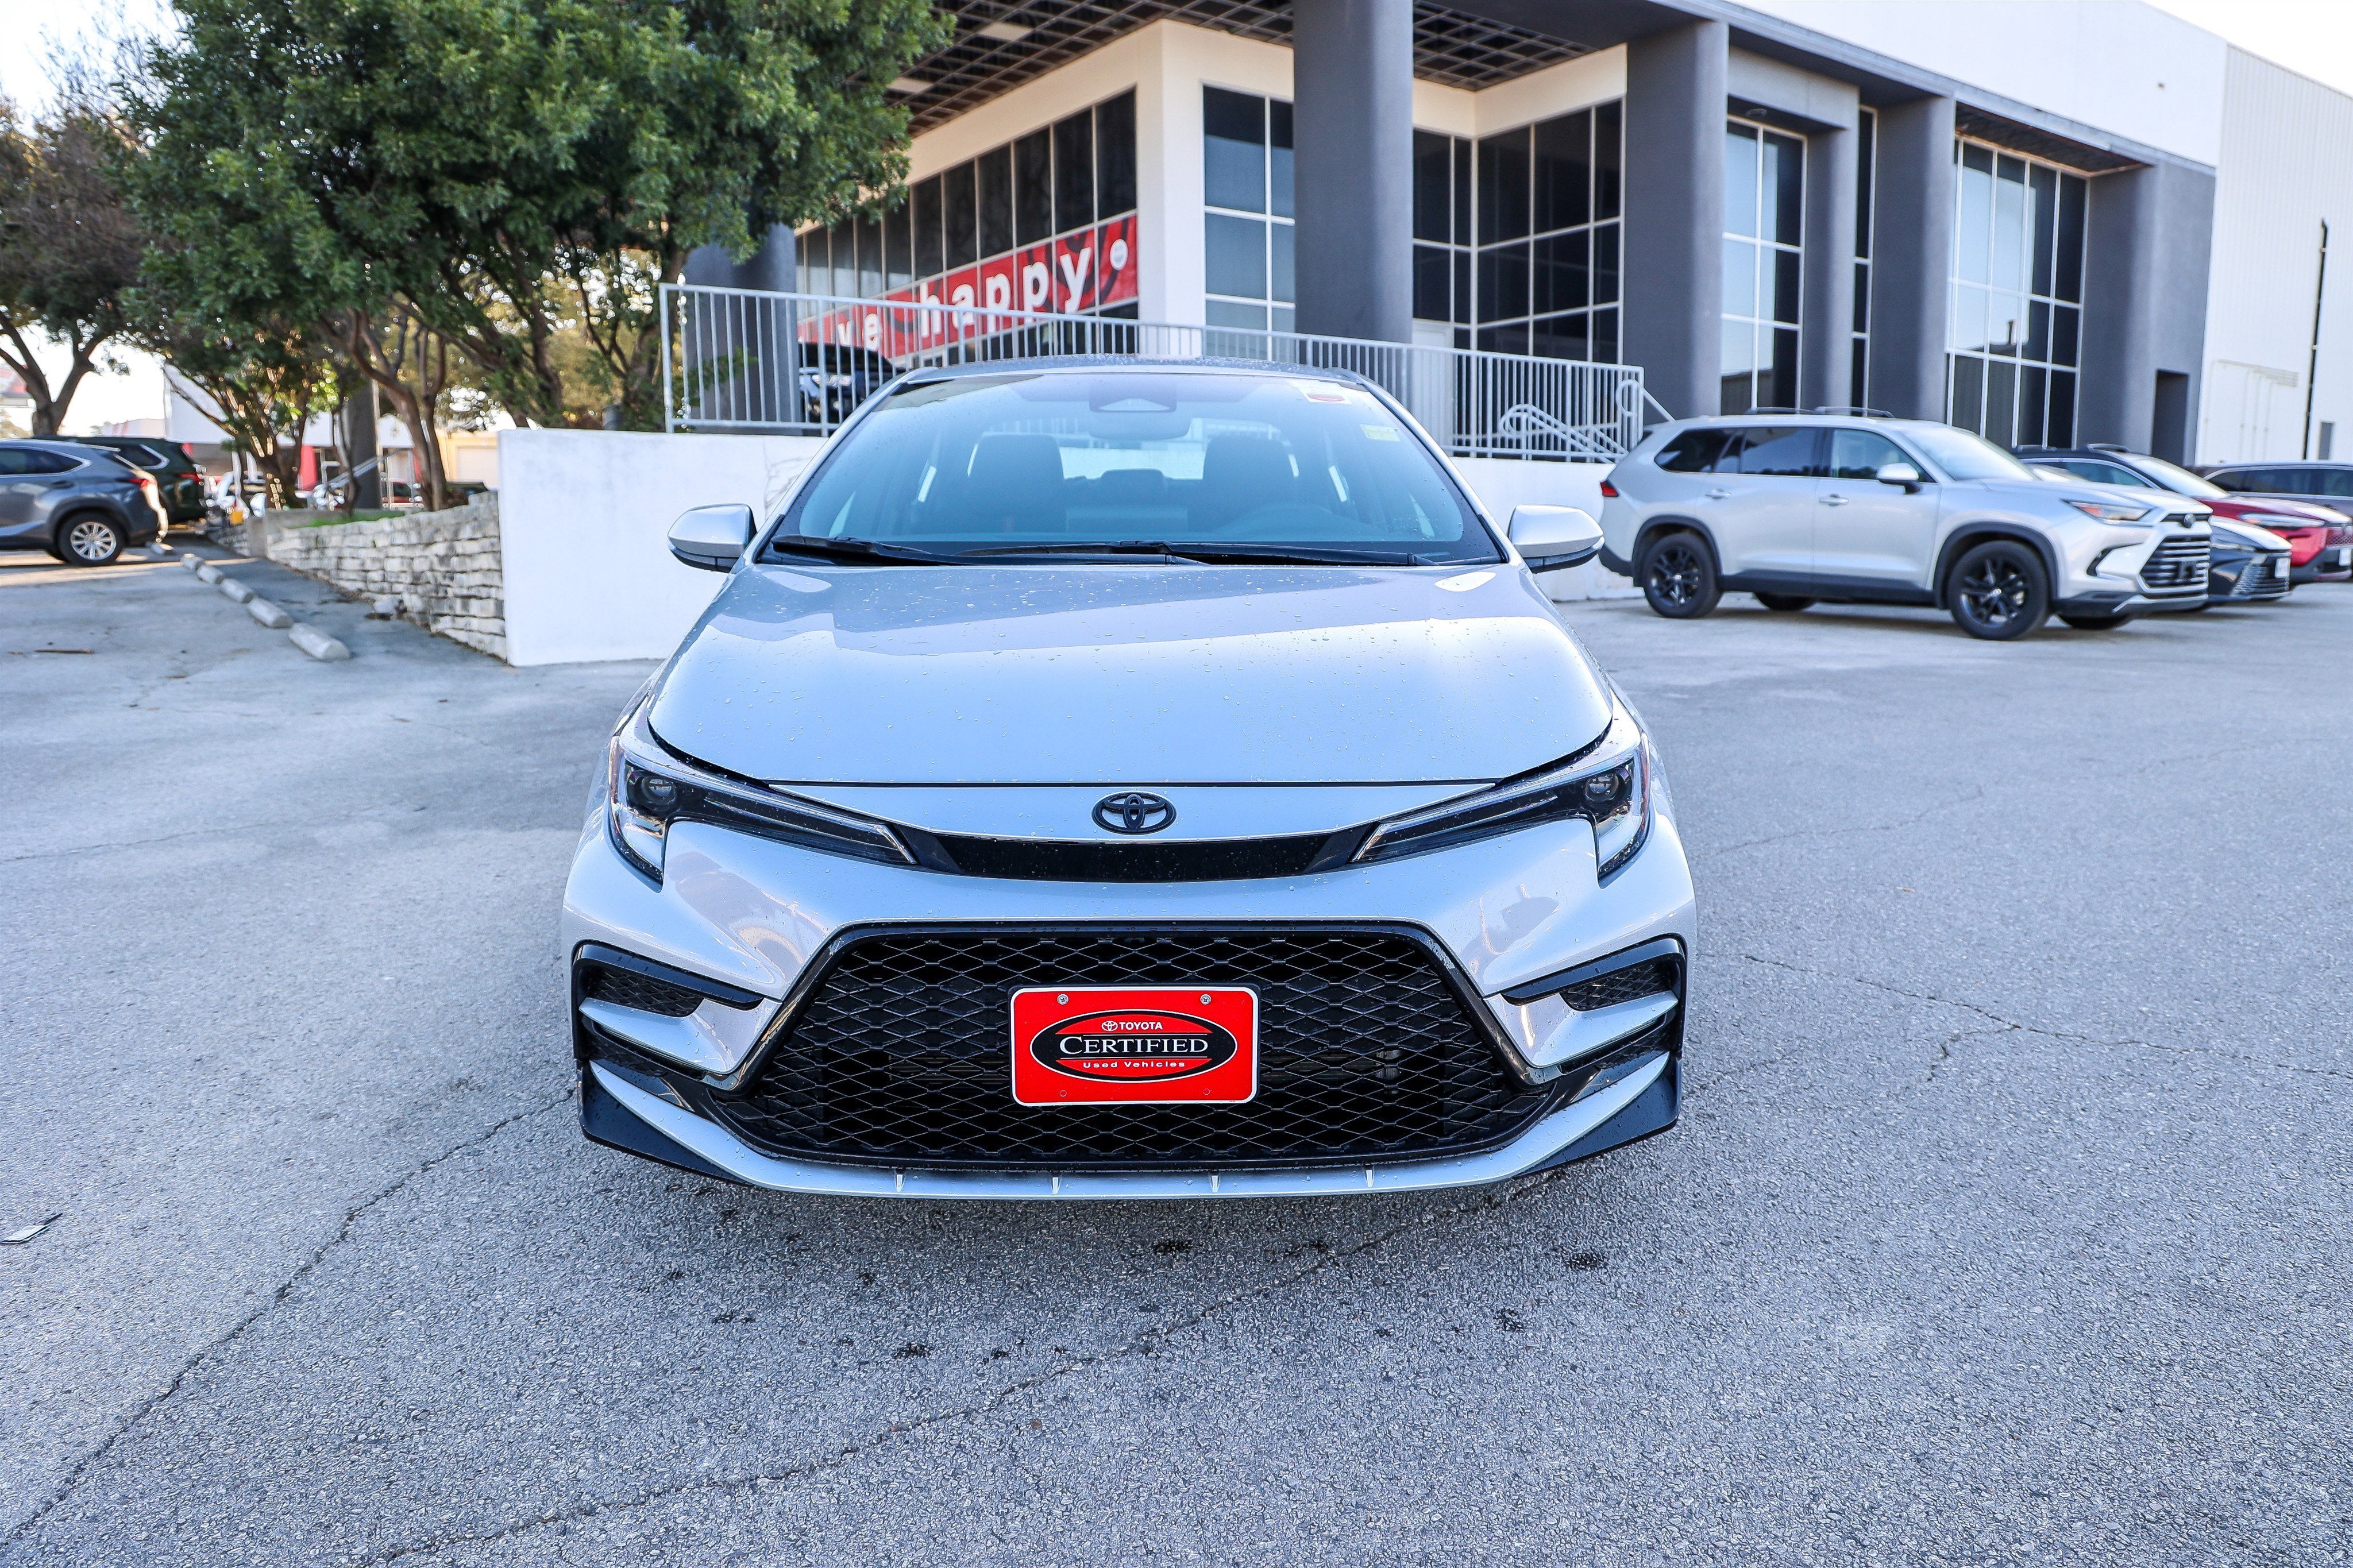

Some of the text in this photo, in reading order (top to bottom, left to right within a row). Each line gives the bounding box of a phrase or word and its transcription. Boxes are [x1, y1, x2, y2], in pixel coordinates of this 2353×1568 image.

[919, 247, 1091, 338] happy
[1119, 1022, 1163, 1030] TOYOTA
[1059, 1036, 1208, 1055] CERTIFIED
